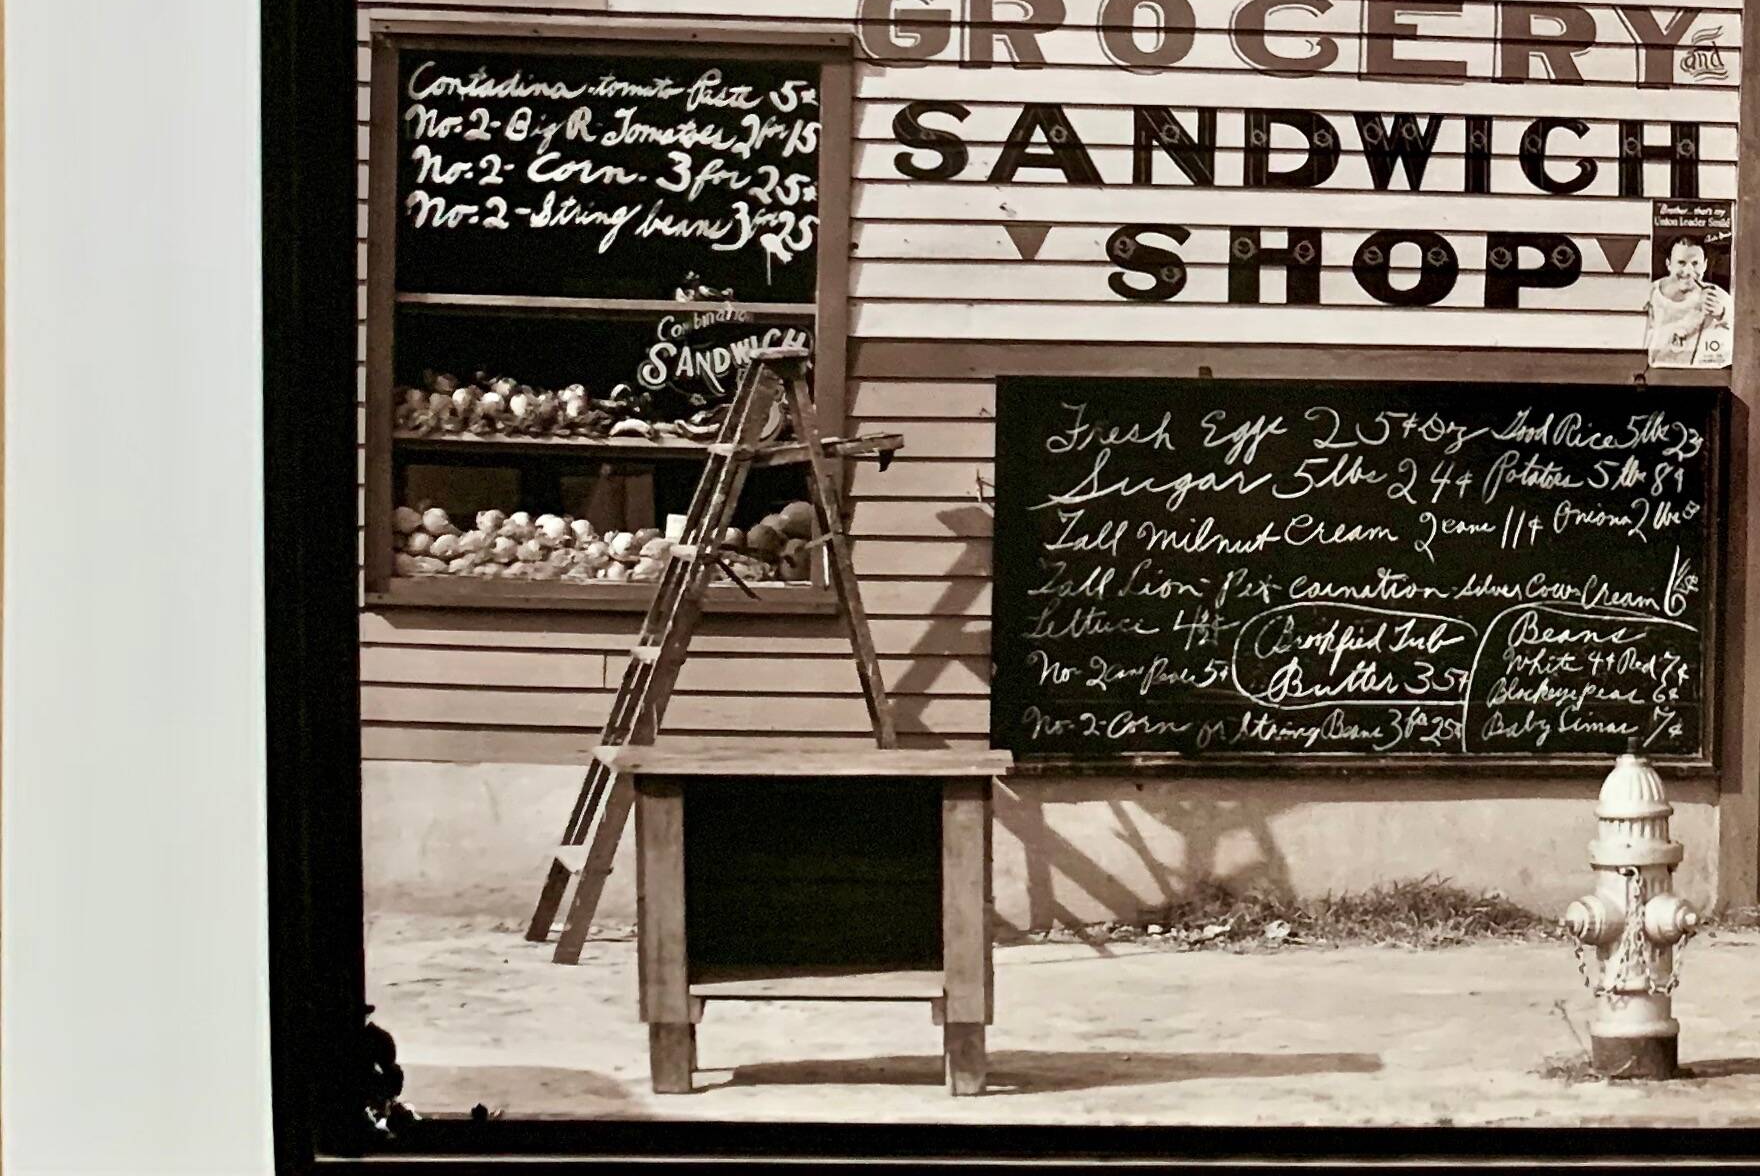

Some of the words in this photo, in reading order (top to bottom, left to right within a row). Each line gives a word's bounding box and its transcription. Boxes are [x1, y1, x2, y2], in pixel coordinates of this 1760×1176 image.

[1680, 34, 1730, 77] and
[892, 100, 1700, 200] SANDWICH
[1105, 223, 1583, 310] SHOP
[1046, 403, 1176, 454] Fresh
[1508, 610, 1647, 651] Beans
